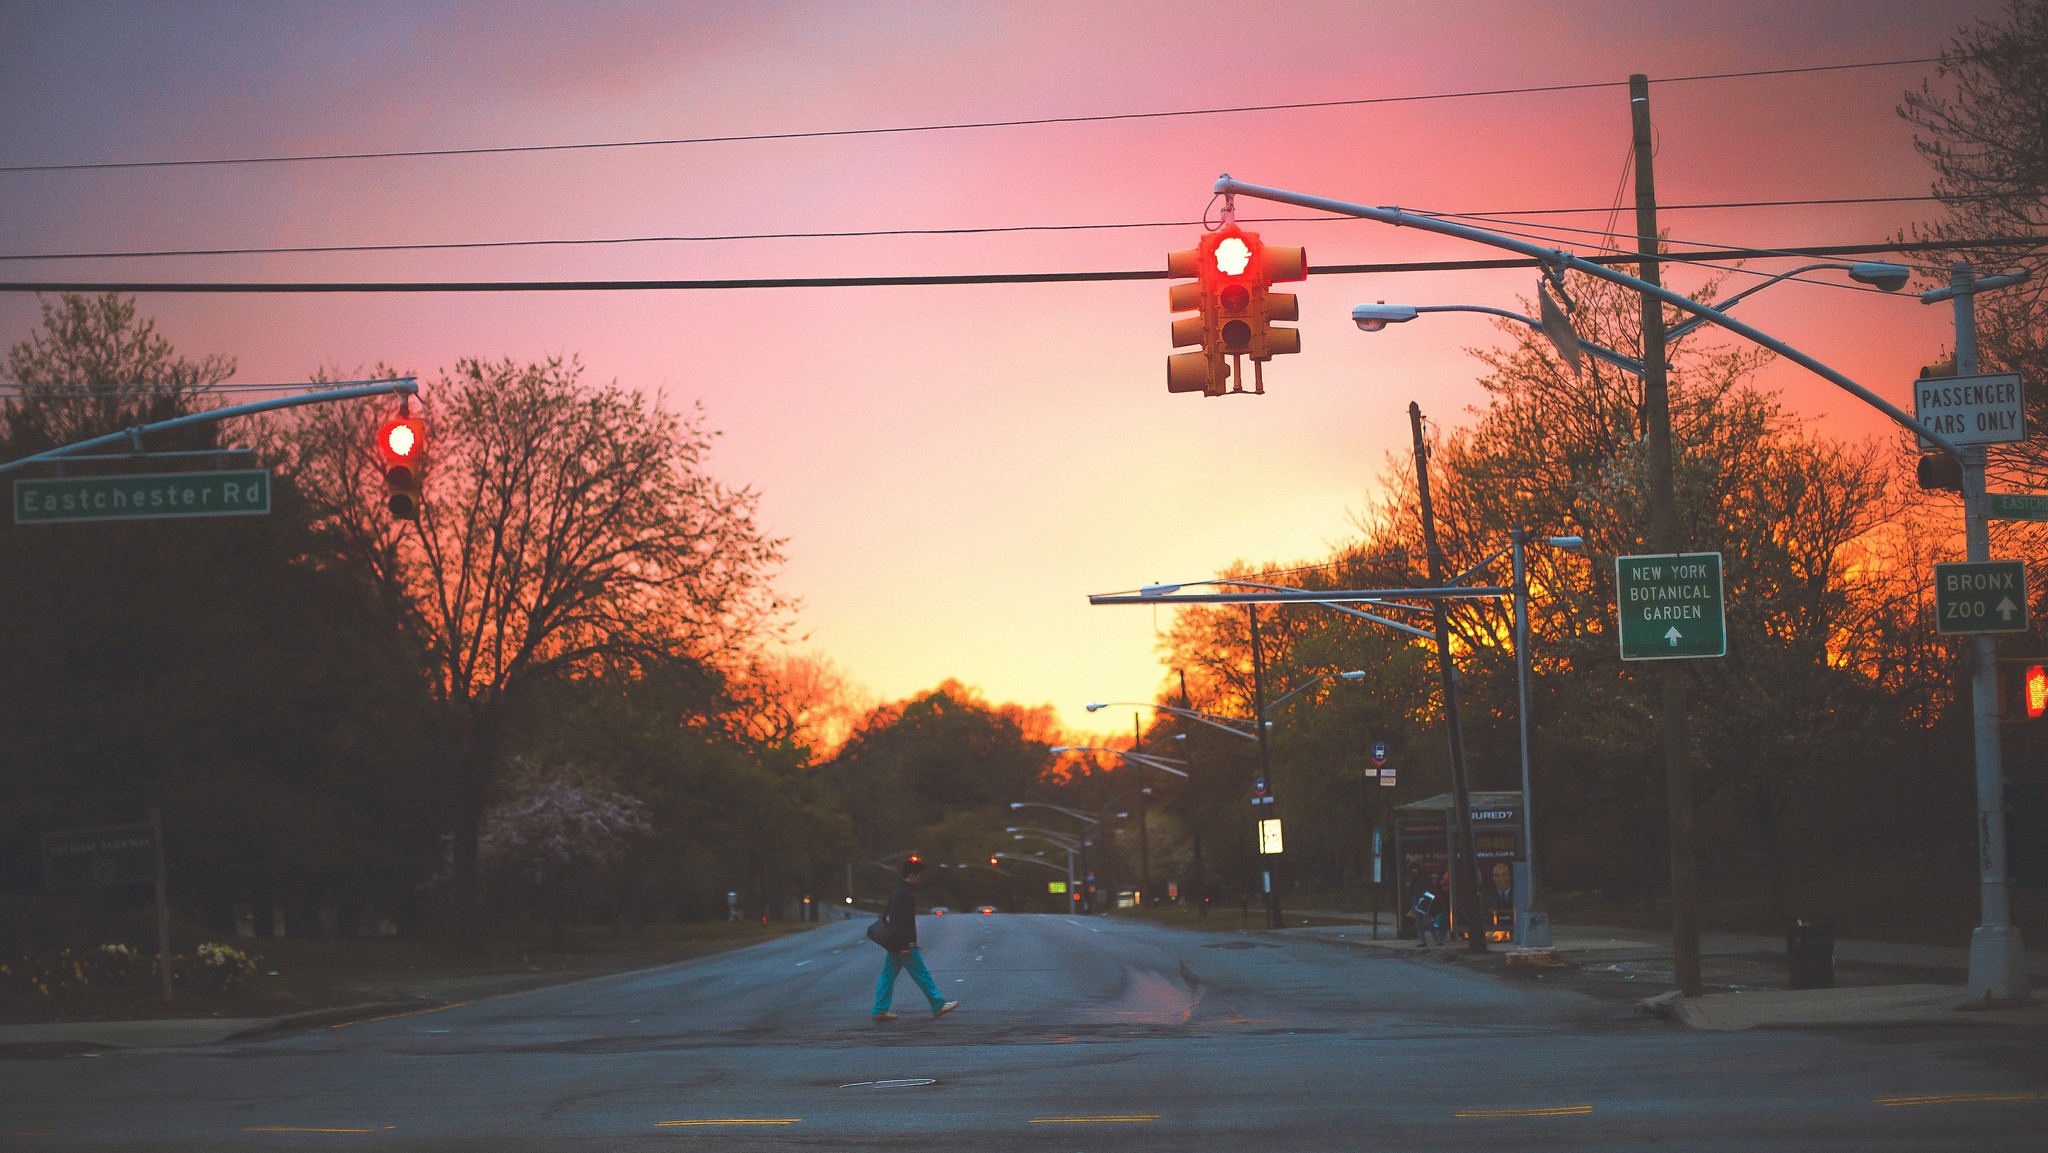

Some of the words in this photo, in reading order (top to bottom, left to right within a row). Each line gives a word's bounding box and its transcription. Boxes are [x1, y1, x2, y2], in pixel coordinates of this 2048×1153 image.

[1922, 383, 2016, 409] PASSENGER
[1924, 414, 1966, 435] CARS
[1977, 411, 2017, 432] ONLY
[23, 486, 212, 512] Eastchester
[223, 482, 259, 504] Rd
[1632, 566, 1662, 581] NEW
[1671, 565, 1707, 580] YORK
[1947, 572, 2014, 592] BRONX
[1630, 585, 1711, 601] BOTANICAL
[1644, 605, 1701, 621] GARDEN
[1947, 601, 1985, 619] ZOO
